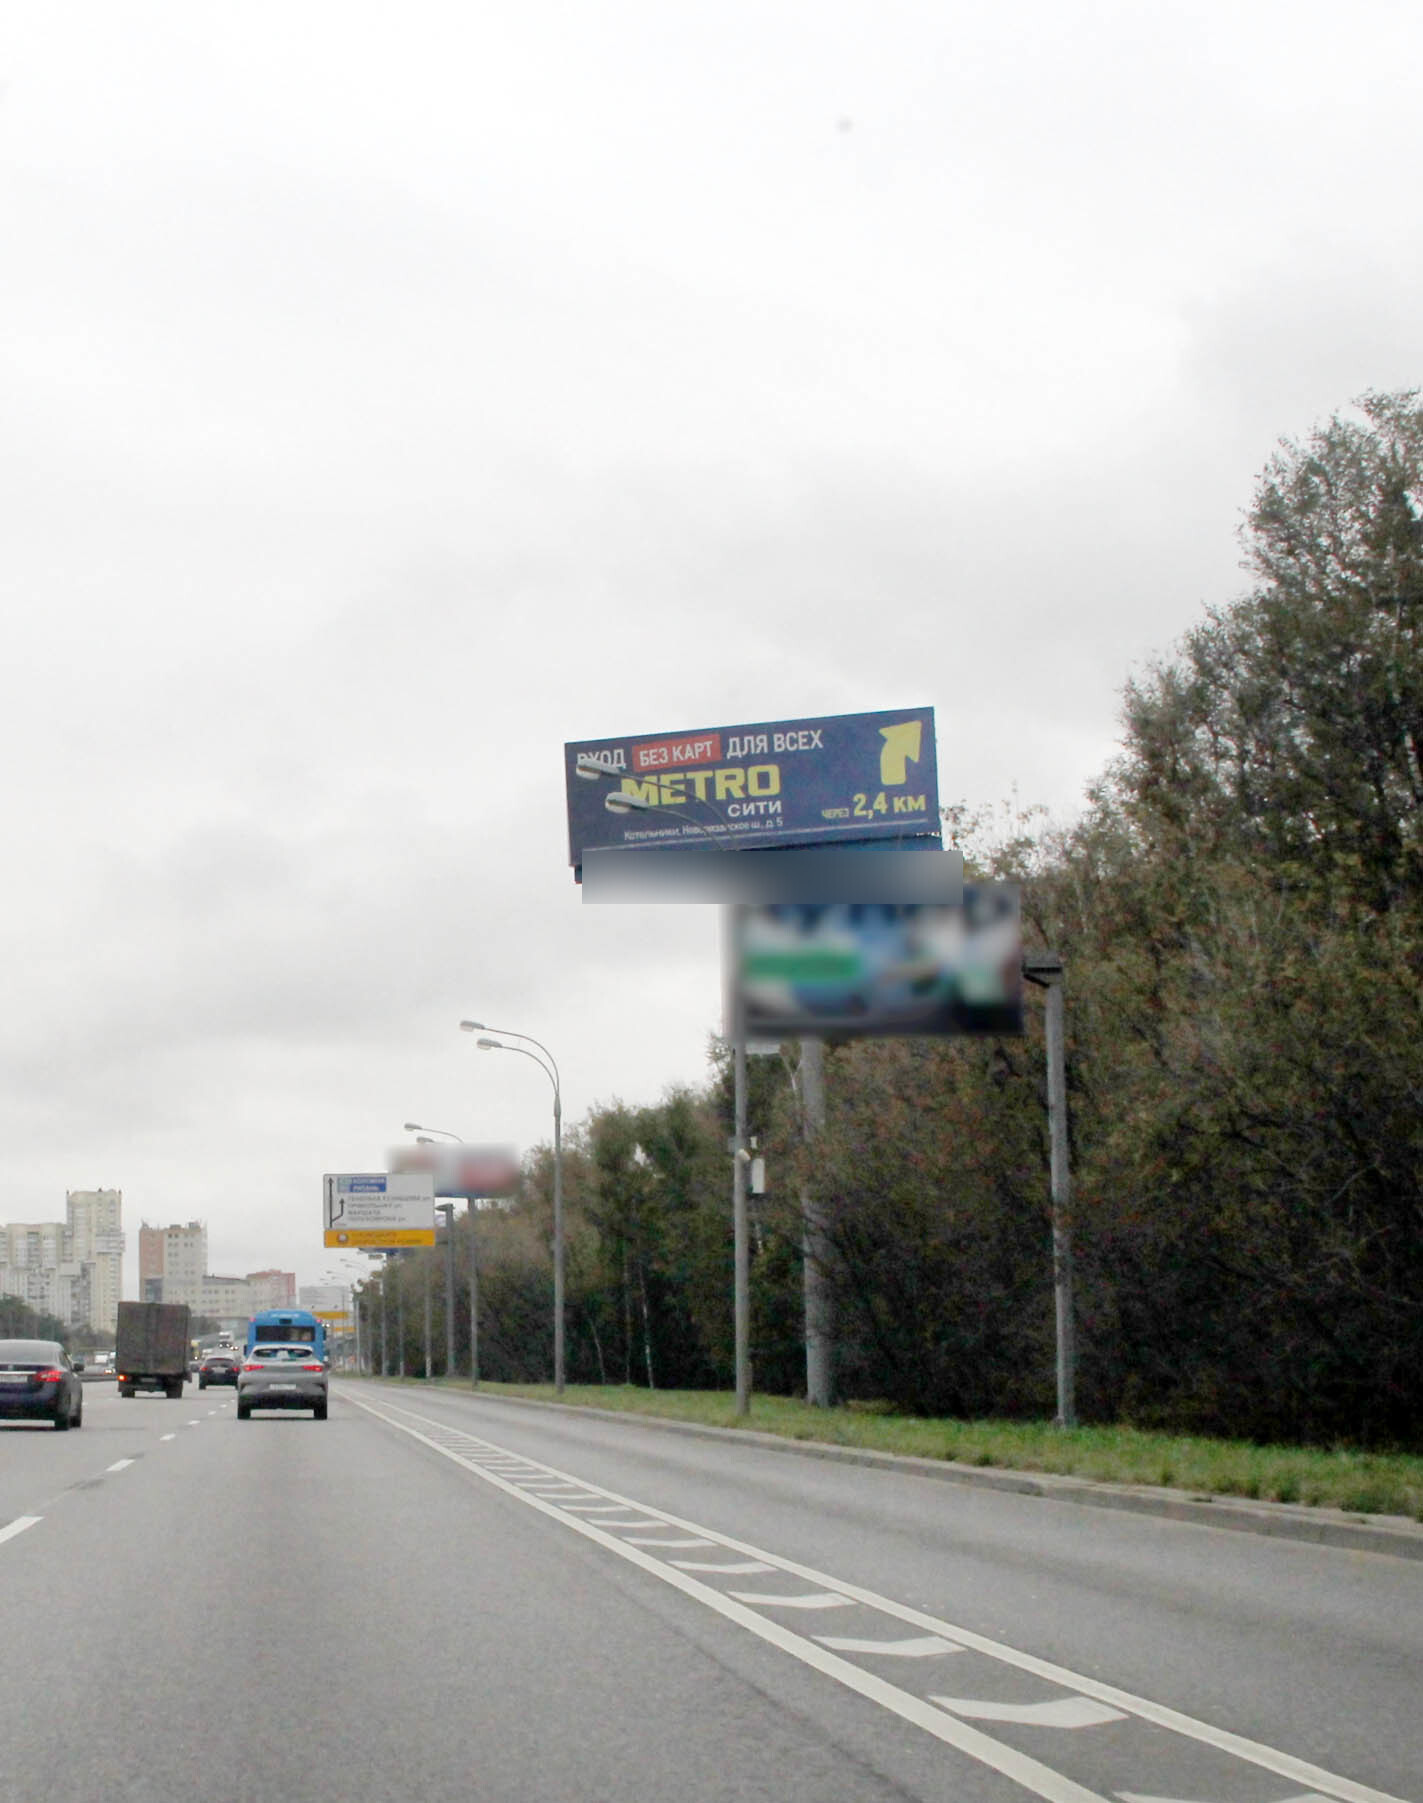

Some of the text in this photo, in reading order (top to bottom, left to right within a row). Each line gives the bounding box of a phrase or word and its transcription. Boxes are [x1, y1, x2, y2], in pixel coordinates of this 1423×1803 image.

[639, 748, 668, 767] БЕЗ
[672, 740, 713, 762] КАРТ
[726, 734, 769, 760] ДЛЯ
[773, 729, 824, 753] ВСЕХ
[621, 764, 781, 807] METRO
[853, 791, 888, 820] 2,4
